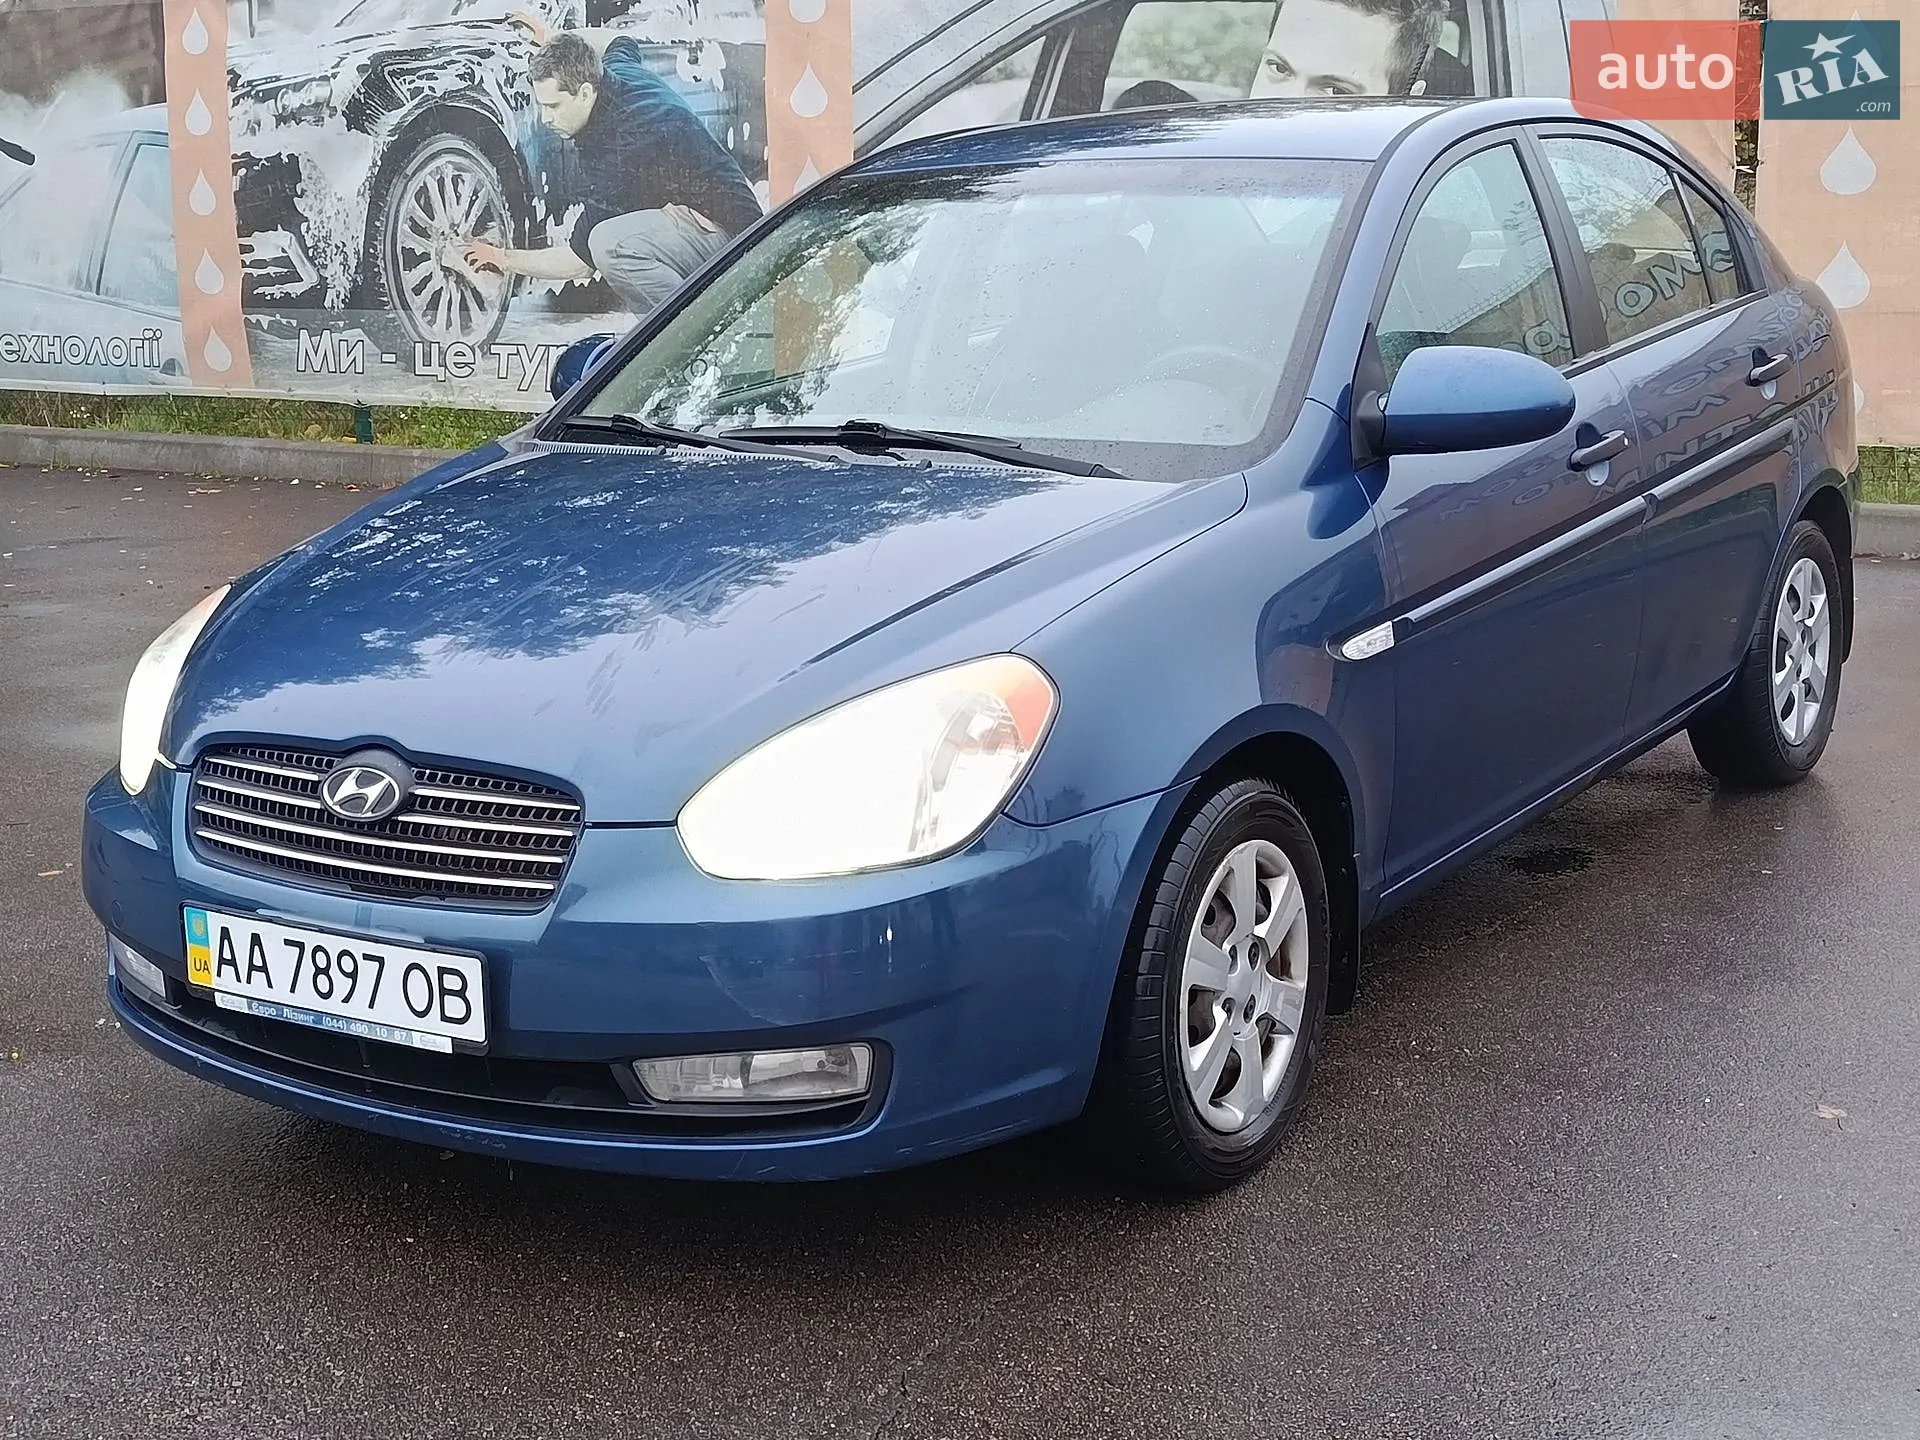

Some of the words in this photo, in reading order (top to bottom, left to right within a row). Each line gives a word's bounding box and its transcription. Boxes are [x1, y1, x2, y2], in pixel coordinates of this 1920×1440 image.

[296, 328, 365, 374] Ми
[414, 341, 476, 382] це
[193, 958, 211, 974] UA
[216, 926, 273, 989] AA
[283, 938, 386, 1009] 7897
[402, 962, 472, 1025] OB
